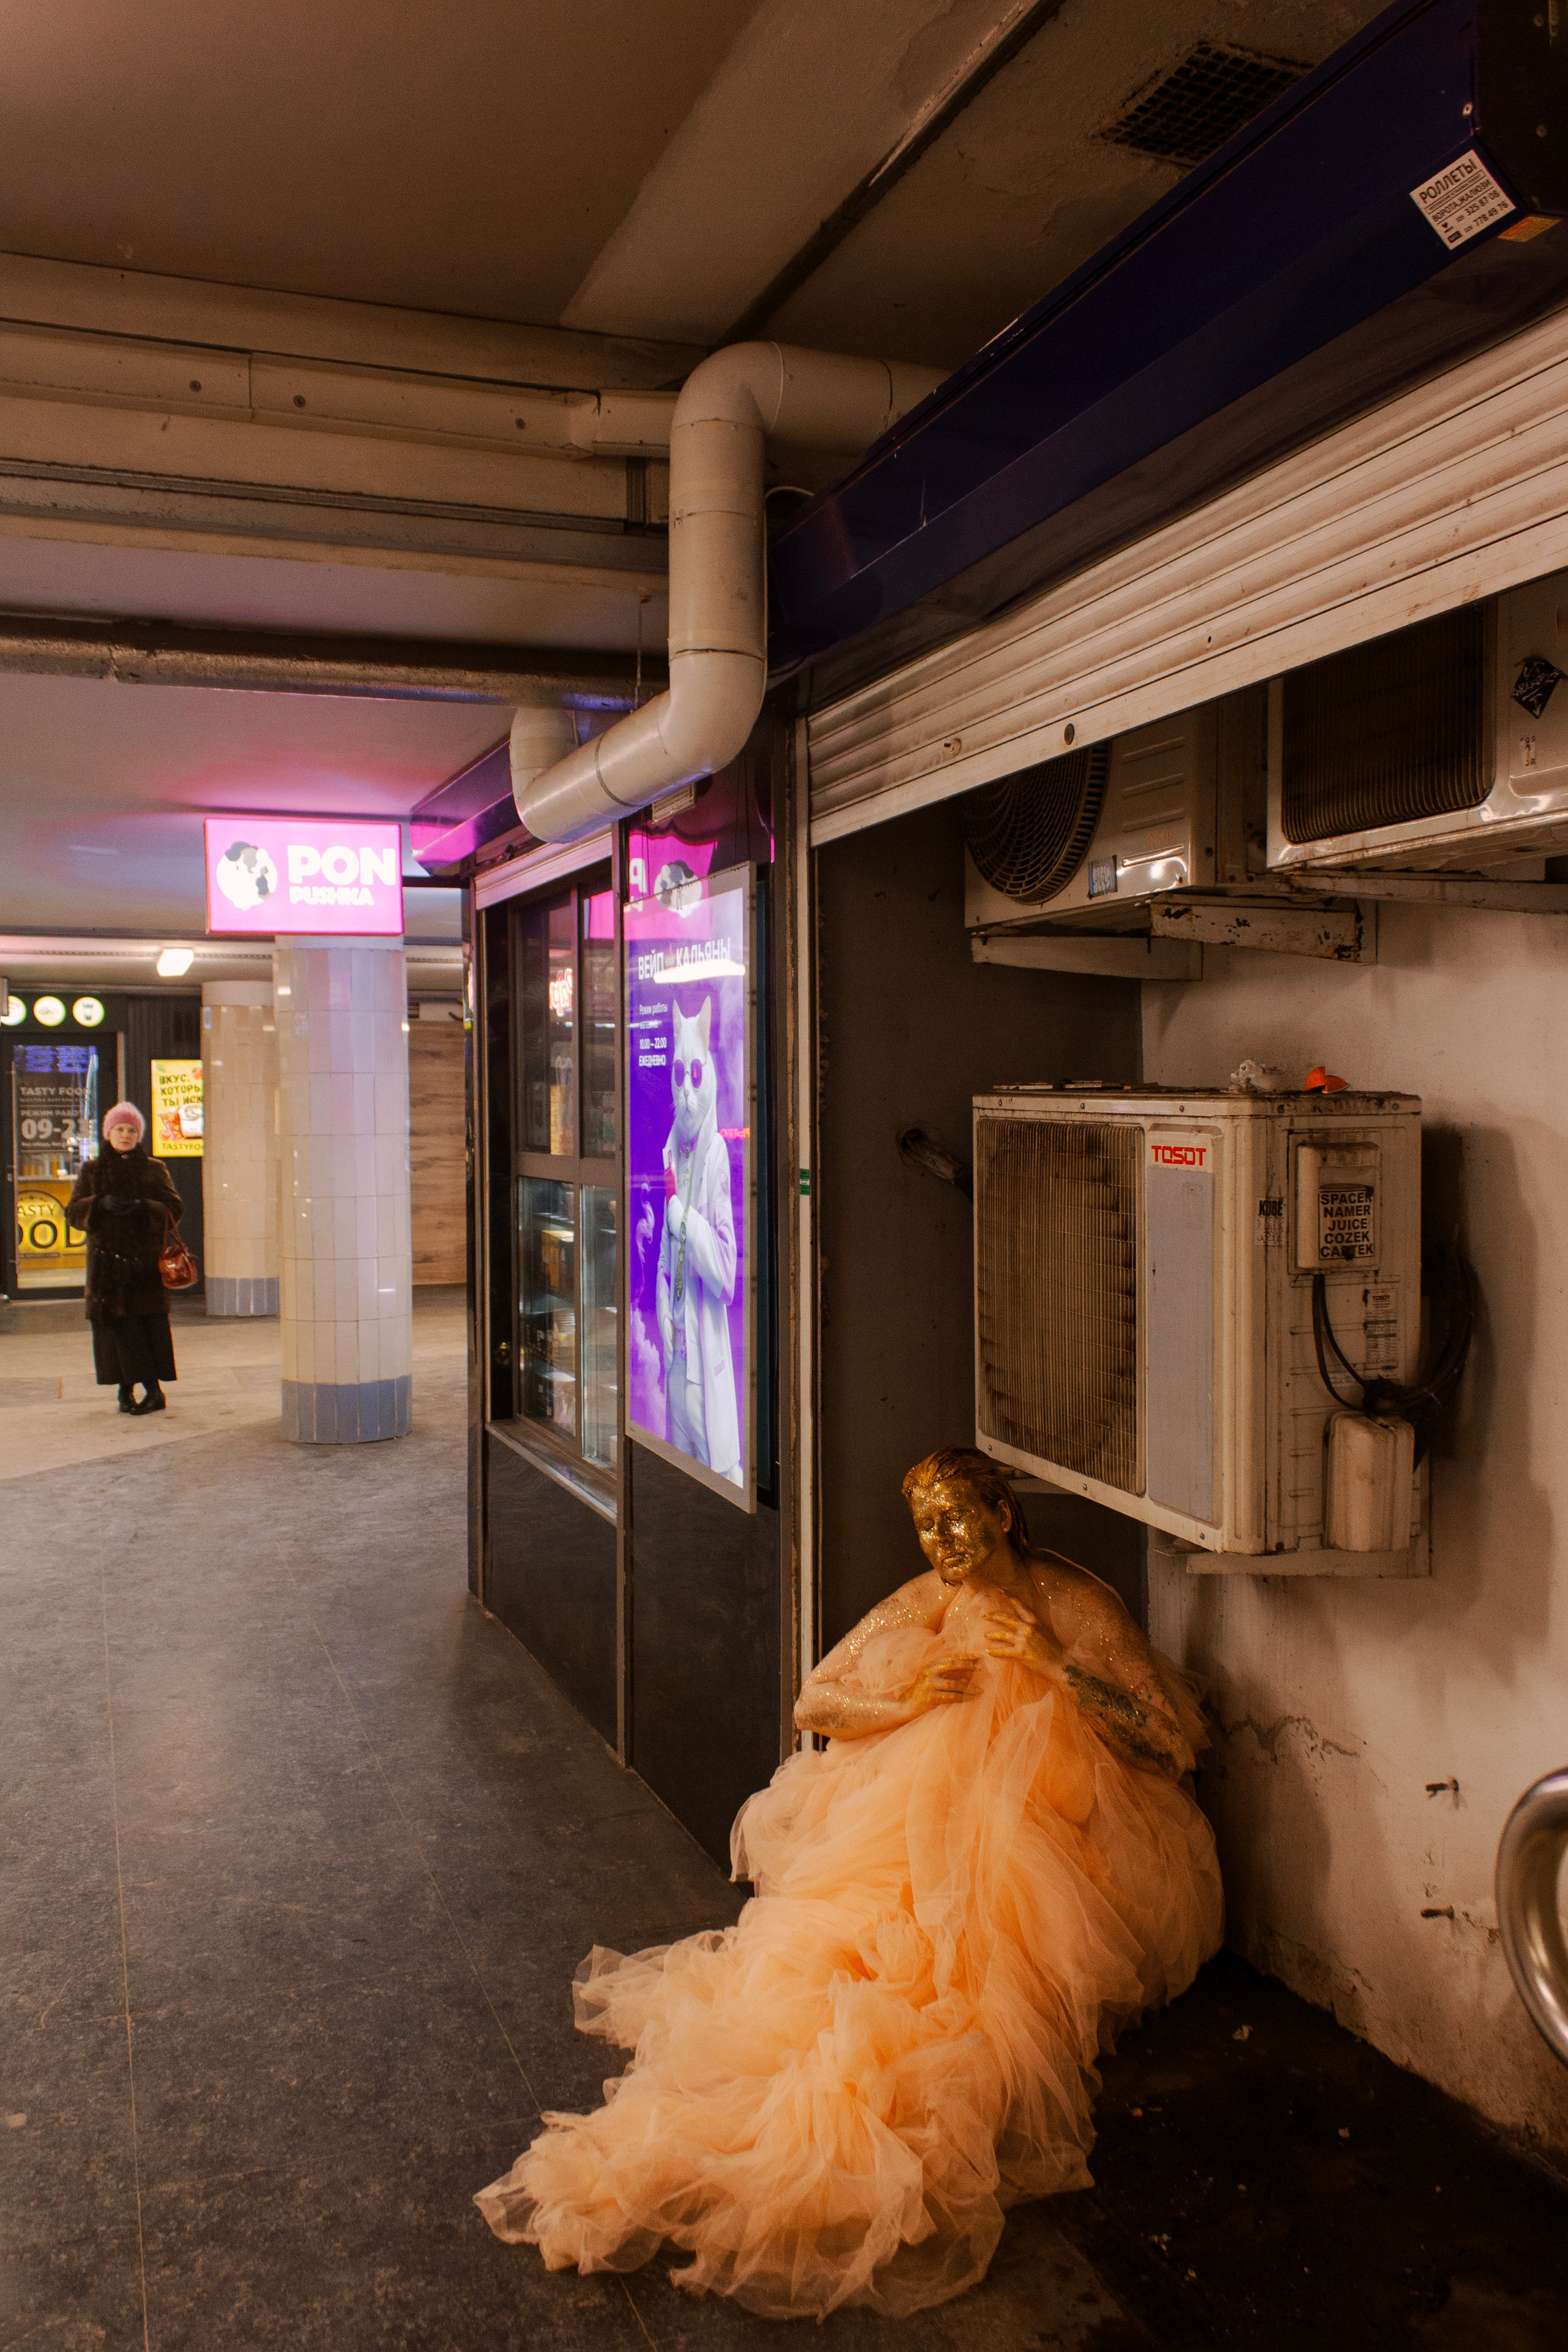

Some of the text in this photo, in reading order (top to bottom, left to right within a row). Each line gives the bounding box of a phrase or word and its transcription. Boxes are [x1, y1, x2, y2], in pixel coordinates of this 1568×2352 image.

[1418, 158, 1477, 203] РОЛЛЕТЫ
[1464, 203, 1479, 216] 325
[1478, 196, 1489, 206] 87
[1488, 189, 1499, 200] 08
[1472, 213, 1488, 226] 778
[1487, 207, 1498, 217] 49
[287, 845, 396, 886] PON
[289, 886, 374, 905] PUSHKA
[638, 937, 731, 980] ВЕЙП КАЛЬЯНЫ
[639, 1003, 668, 1016] Режим работы
[639, 1055, 666, 1067] ЕЖЕДНЕВНО
[162, 1098, 179, 1107] ТЫ
[1152, 1145, 1206, 1166] TOSOT
[1321, 1192, 1373, 1205] SPACER
[1324, 1205, 1371, 1218] NAMER
[1328, 1218, 1367, 1231] JUICE
[1324, 1231, 1370, 1244] COZEK
